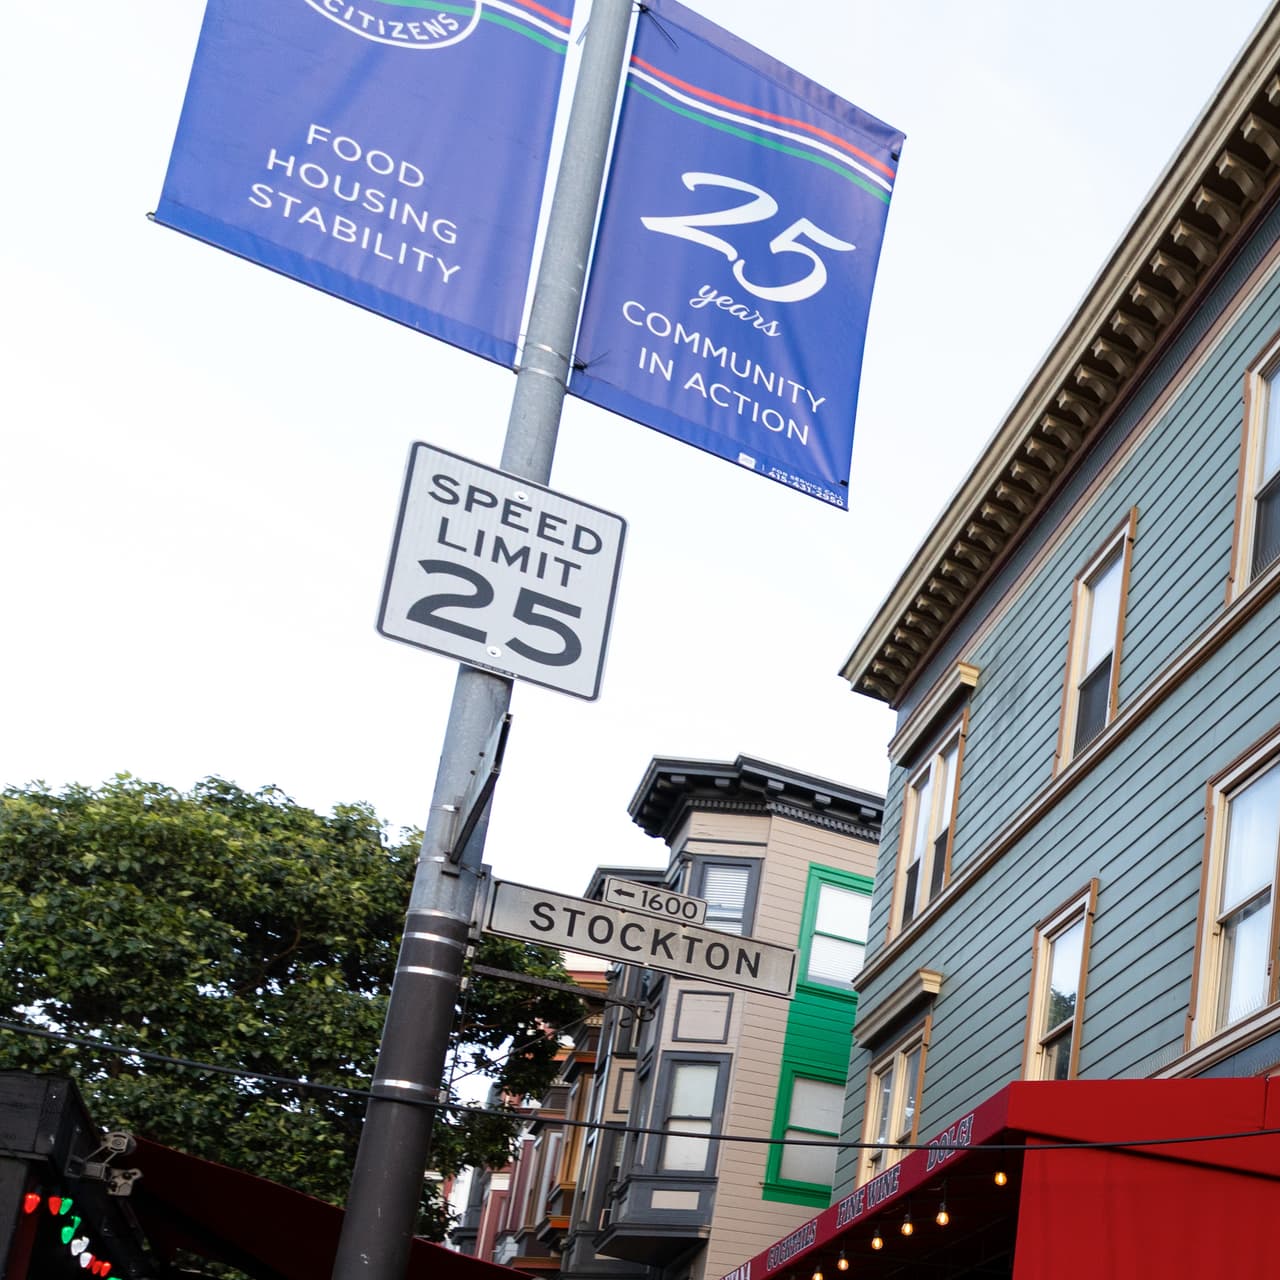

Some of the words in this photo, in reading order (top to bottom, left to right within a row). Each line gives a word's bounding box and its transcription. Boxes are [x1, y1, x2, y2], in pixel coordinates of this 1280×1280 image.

[323, 0, 459, 41] CITIZENS
[307, 123, 424, 187] FOOD
[248, 183, 461, 283] STABILITY
[267, 148, 457, 244] HOUSING
[640, 172, 857, 302] 25
[689, 284, 781, 337] years
[622, 300, 826, 413] COMMUNITY
[638, 347, 674, 381] IN
[684, 372, 809, 446] ACTION
[427, 473, 603, 555] SPEED
[437, 516, 582, 588] LIMIT
[406, 559, 582, 667] 25
[529, 901, 761, 979] STOCKTON
[641, 890, 699, 921] 1600
[926, 1113, 975, 1172] DOLCI
[836, 1187, 865, 1229] FINE
[866, 1164, 902, 1210] WINE
[766, 1219, 818, 1272] COCKTAILS
